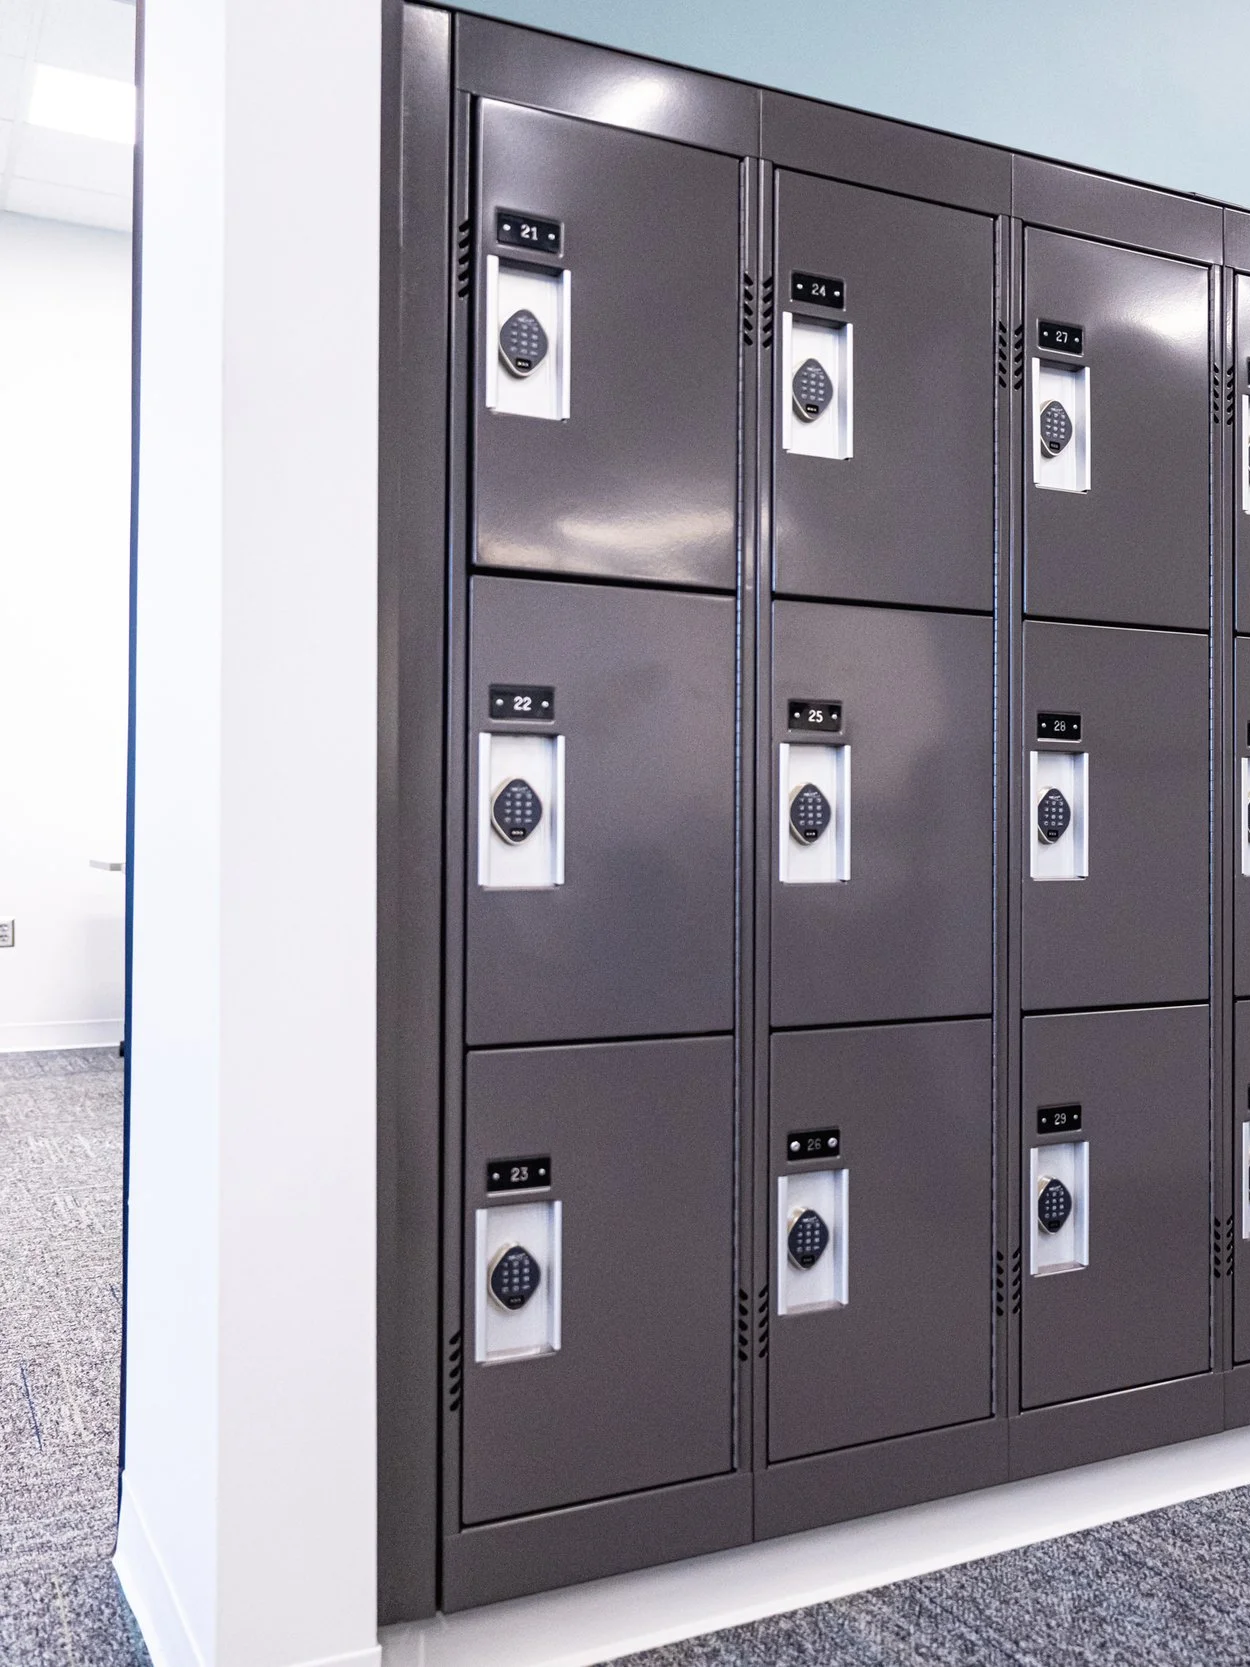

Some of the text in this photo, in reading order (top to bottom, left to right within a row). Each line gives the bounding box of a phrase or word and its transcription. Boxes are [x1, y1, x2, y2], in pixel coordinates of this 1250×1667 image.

[520, 224, 538, 241] 21
[811, 283, 826, 297] 24
[1056, 331, 1068, 343] 27
[513, 696, 532, 711] 22
[808, 710, 823, 723] 25
[1054, 720, 1065, 732] 28
[1054, 1113, 1066, 1125] 29
[807, 1138, 822, 1151] 26
[510, 1167, 529, 1182] 23
